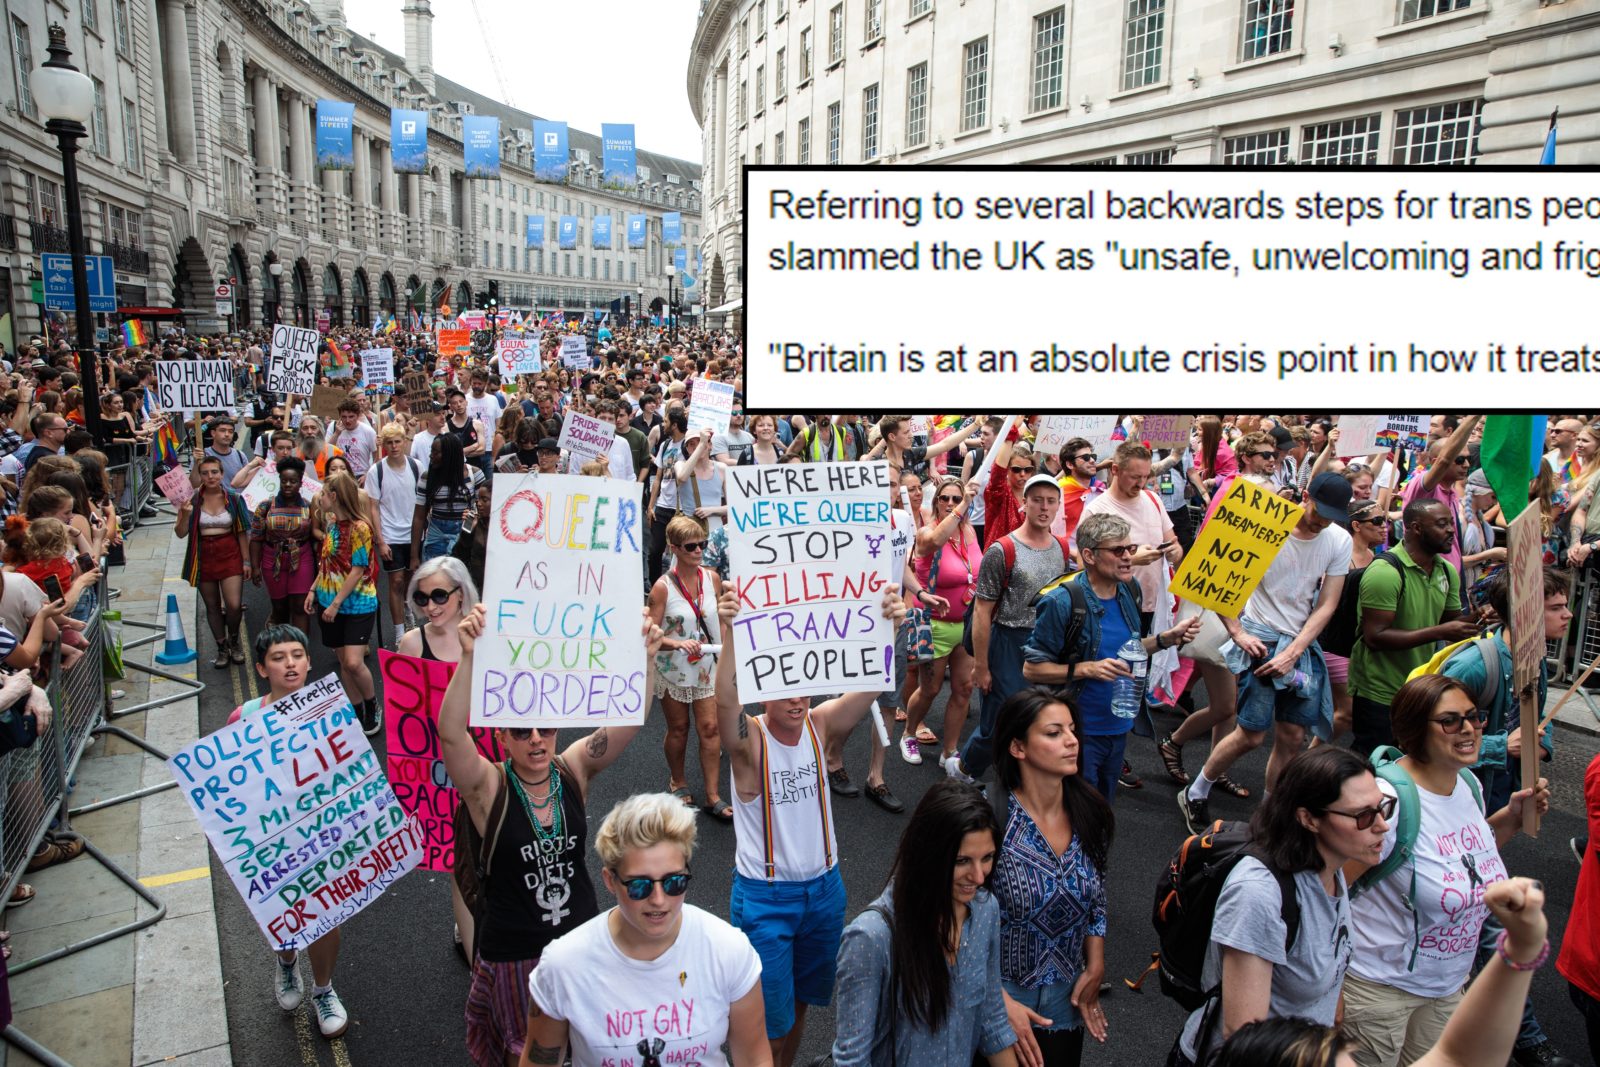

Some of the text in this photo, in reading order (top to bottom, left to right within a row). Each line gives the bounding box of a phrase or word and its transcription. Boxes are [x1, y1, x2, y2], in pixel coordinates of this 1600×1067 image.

[274, 326, 318, 354] QUEER
[441, 321, 457, 330] NO
[500, 340, 528, 348] EQUAL
[158, 361, 232, 383] NO HUMAN
[271, 356, 315, 374] FUCK
[282, 369, 297, 377] YOUR
[160, 383, 234, 408] IS ILLEGAL
[268, 374, 313, 395] BORDERS
[571, 414, 601, 432] PRIDE
[1144, 418, 1175, 431] EVERY
[1386, 423, 1418, 433] BORDERS
[1406, 415, 1419, 423] THE
[1140, 430, 1186, 443] DEPORTEE
[732, 465, 890, 498] WE'RE HERE
[731, 500, 889, 533] WE'RE QUEER
[1229, 483, 1297, 525] ARMY
[500, 489, 640, 553] QUEER
[1212, 504, 1290, 547] DREAMERS?
[752, 530, 854, 565] STOP
[1208, 538, 1260, 569] NOT
[515, 560, 605, 596] AS IN
[736, 569, 887, 610] KILLING
[1182, 572, 1241, 606] NAME!
[1198, 558, 1251, 590] IN MY
[497, 599, 616, 640] FUCK
[733, 605, 875, 651] TRANS
[507, 639, 607, 670] YOUR
[745, 644, 893, 691] PEOPLE!
[273, 679, 343, 716] #FreeHer
[482, 669, 645, 718] BORDERS
[174, 710, 285, 783] POLICE
[191, 703, 357, 811] PROTECTION
[215, 729, 353, 823] IS A LIE
[388, 757, 430, 783] YOU
[239, 837, 291, 879] SEX
[296, 773, 388, 839] WORKERS
[1435, 822, 1487, 857] NOT GAY
[248, 790, 396, 900] ARRESTED TO BE
[278, 805, 405, 907] DEPORTED
[520, 835, 578, 862] RIOTS
[524, 861, 575, 890] DIETS
[1443, 871, 1456, 883] AS
[267, 899, 317, 944] FOR
[311, 865, 368, 910] THEIR
[606, 997, 694, 1038] NOT GAY
[601, 1058, 615, 1067] AS
[620, 1056, 634, 1067] IN
[666, 1040, 708, 1064] HAPPY
